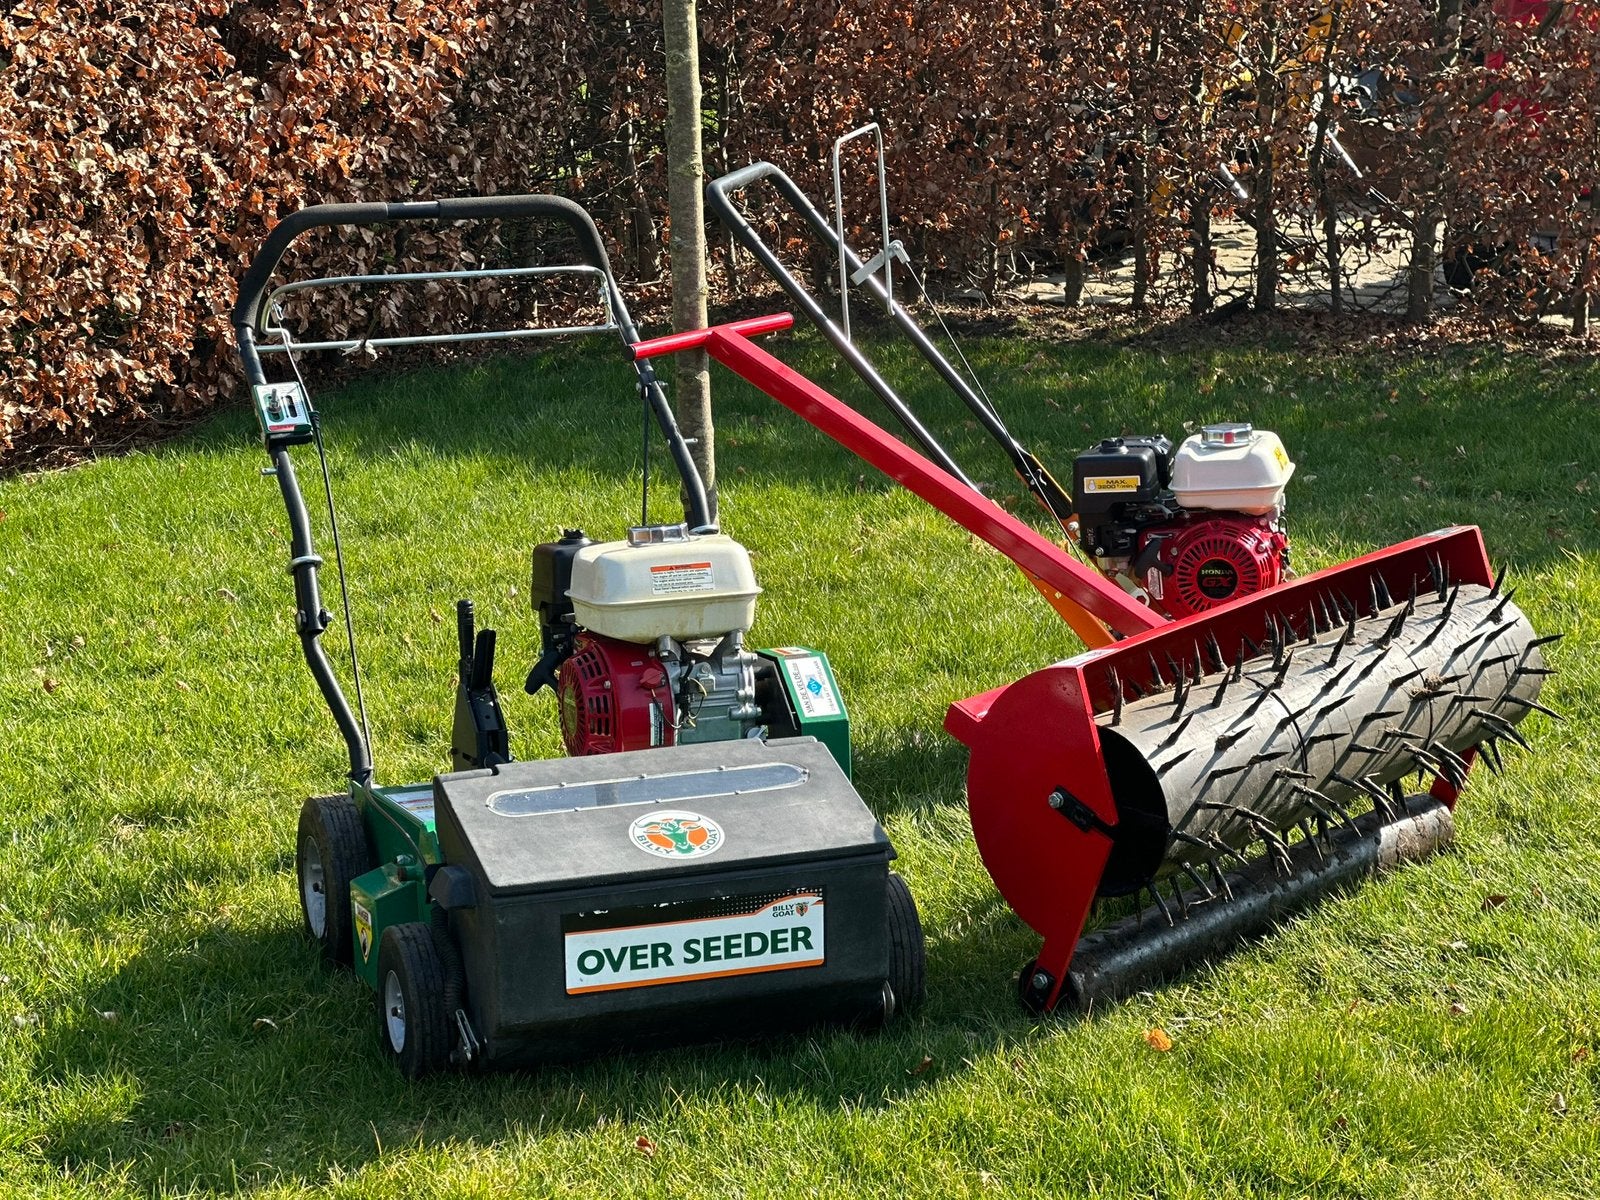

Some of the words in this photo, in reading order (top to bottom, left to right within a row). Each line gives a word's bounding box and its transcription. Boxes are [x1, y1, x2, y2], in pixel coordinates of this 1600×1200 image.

[1202, 576, 1233, 587] GX
[804, 701, 814, 714] VAN
[636, 835, 674, 854] BILLY
[699, 828, 718, 851] GOAT
[772, 904, 795, 912] BILLY
[772, 910, 795, 918] GOAT
[576, 941, 674, 976] OVER
[683, 926, 814, 965] SEEDER
